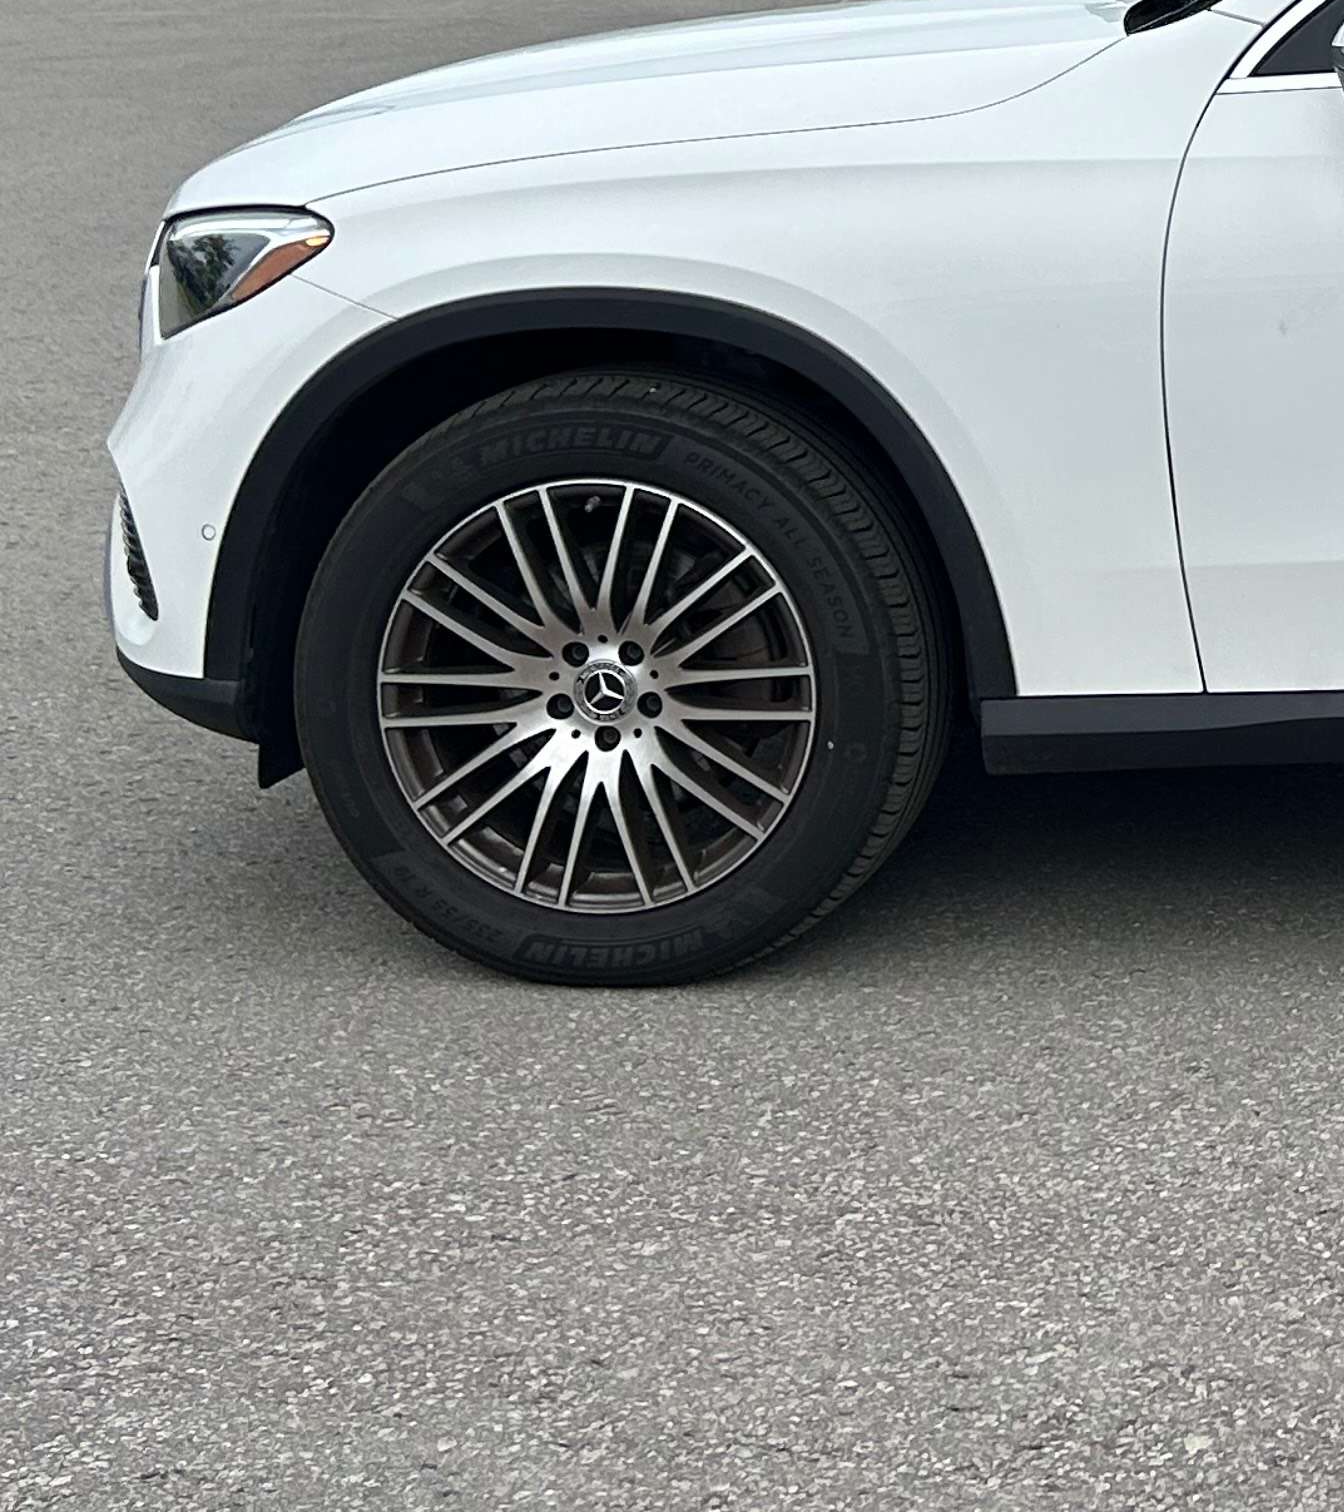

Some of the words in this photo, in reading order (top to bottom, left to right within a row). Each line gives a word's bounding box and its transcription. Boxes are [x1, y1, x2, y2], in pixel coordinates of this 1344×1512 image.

[479, 425, 664, 465] MICHELIN
[683, 451, 774, 511] PRIMACY
[522, 928, 703, 970] MICHELIN
